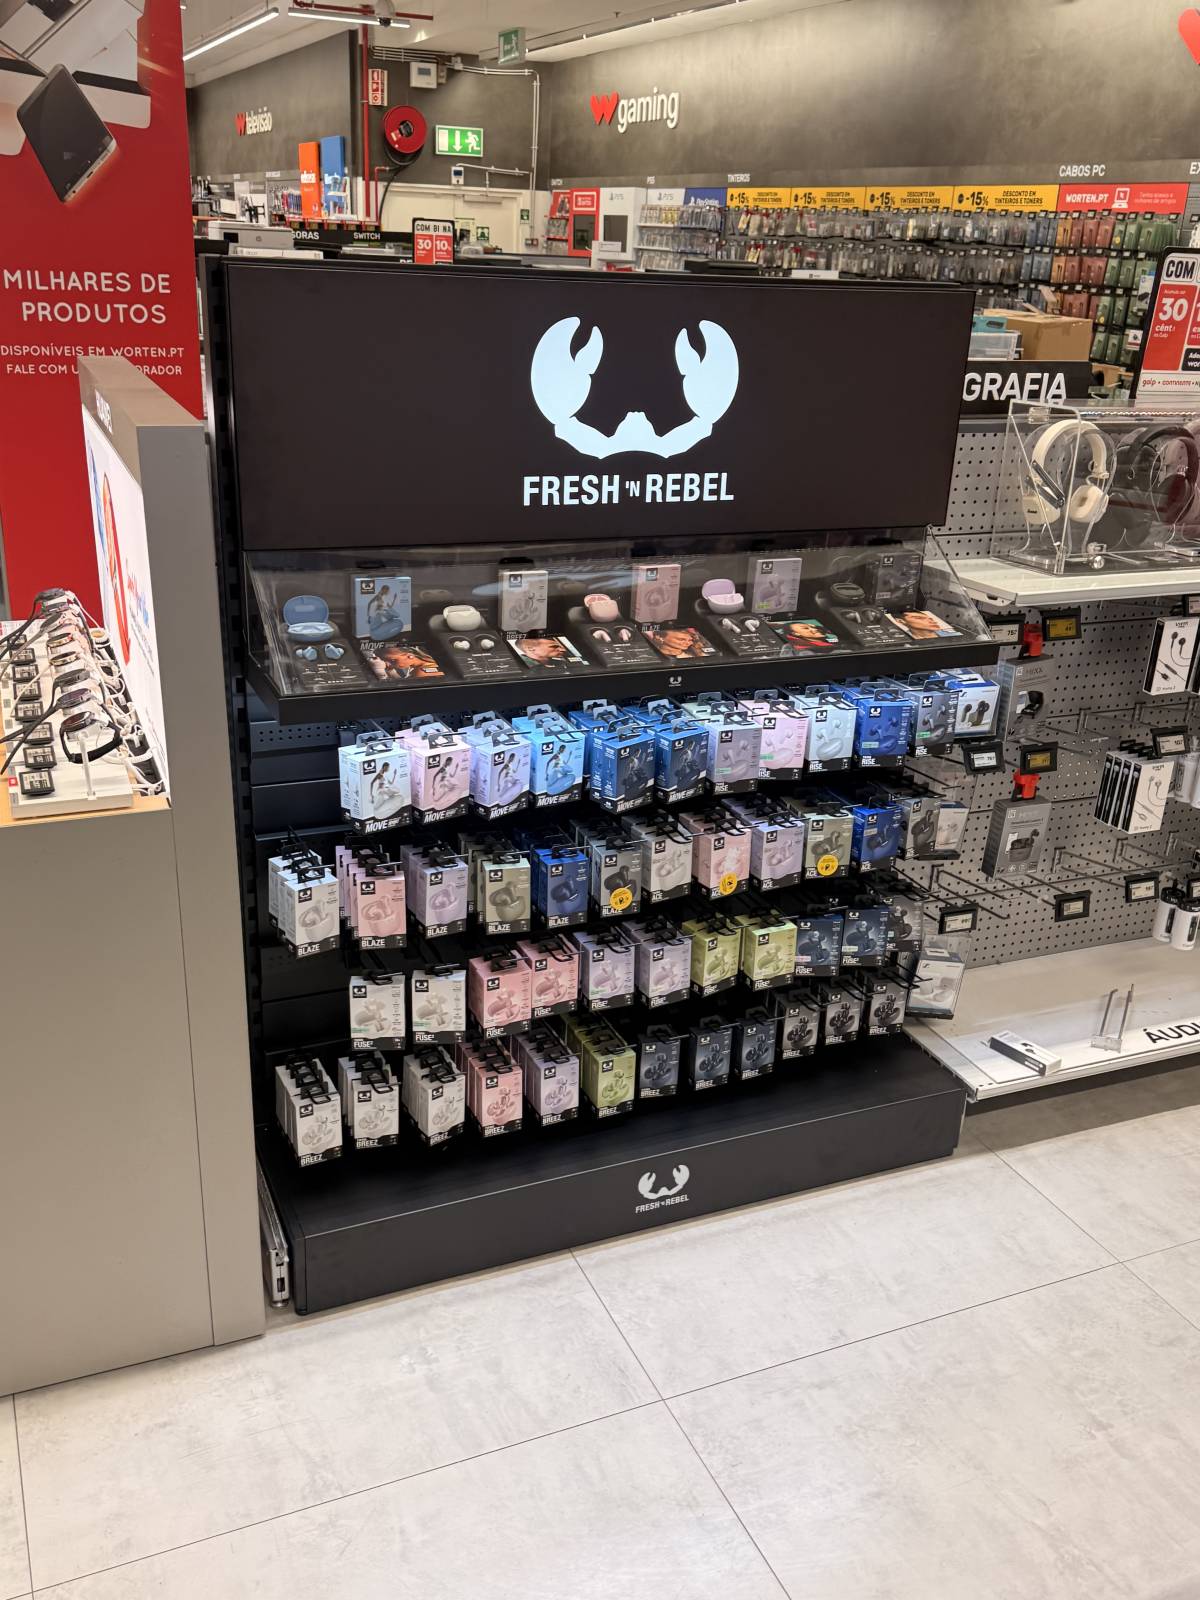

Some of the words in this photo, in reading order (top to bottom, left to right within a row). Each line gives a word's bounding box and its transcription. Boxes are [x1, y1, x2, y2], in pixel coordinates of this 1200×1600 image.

[617, 86, 680, 134] gaming
[1059, 164, 1091, 177] CABOS
[1092, 164, 1106, 176] PC
[876, 191, 896, 206] -15%
[966, 191, 989, 207] -15%
[1065, 193, 1109, 204] WORTEN.PT
[353, 232, 381, 241] SWITCH
[417, 239, 432, 250] 30
[1165, 259, 1195, 280] COM
[3, 269, 131, 293] MILHARES
[141, 273, 171, 294] DE
[22, 301, 167, 325] PRODUTOS
[1158, 297, 1189, 321] 30
[0, 343, 84, 357] DISPONÍVEIS
[88, 346, 105, 357] EM
[111, 347, 185, 359] WORTEN.PT
[7, 364, 36, 375] FALE
[38, 364, 68, 375] COM
[962, 372, 1067, 402] GRAFIA
[522, 473, 620, 507] FRESH
[625, 480, 641, 498] 'N
[645, 471, 735, 504] REBEL
[537, 796, 559, 807] MOVE
[424, 810, 445, 824] MOVE
[365, 820, 389, 834] MOVE
[488, 923, 511, 932] BLAZE
[549, 916, 569, 927] BLAZE
[427, 926, 448, 937] BLAZE
[298, 944, 321, 956] BLAZE
[361, 939, 386, 948] BLAZE
[635, 1201, 660, 1214] FRESH
[665, 1194, 690, 1207] REBEL
